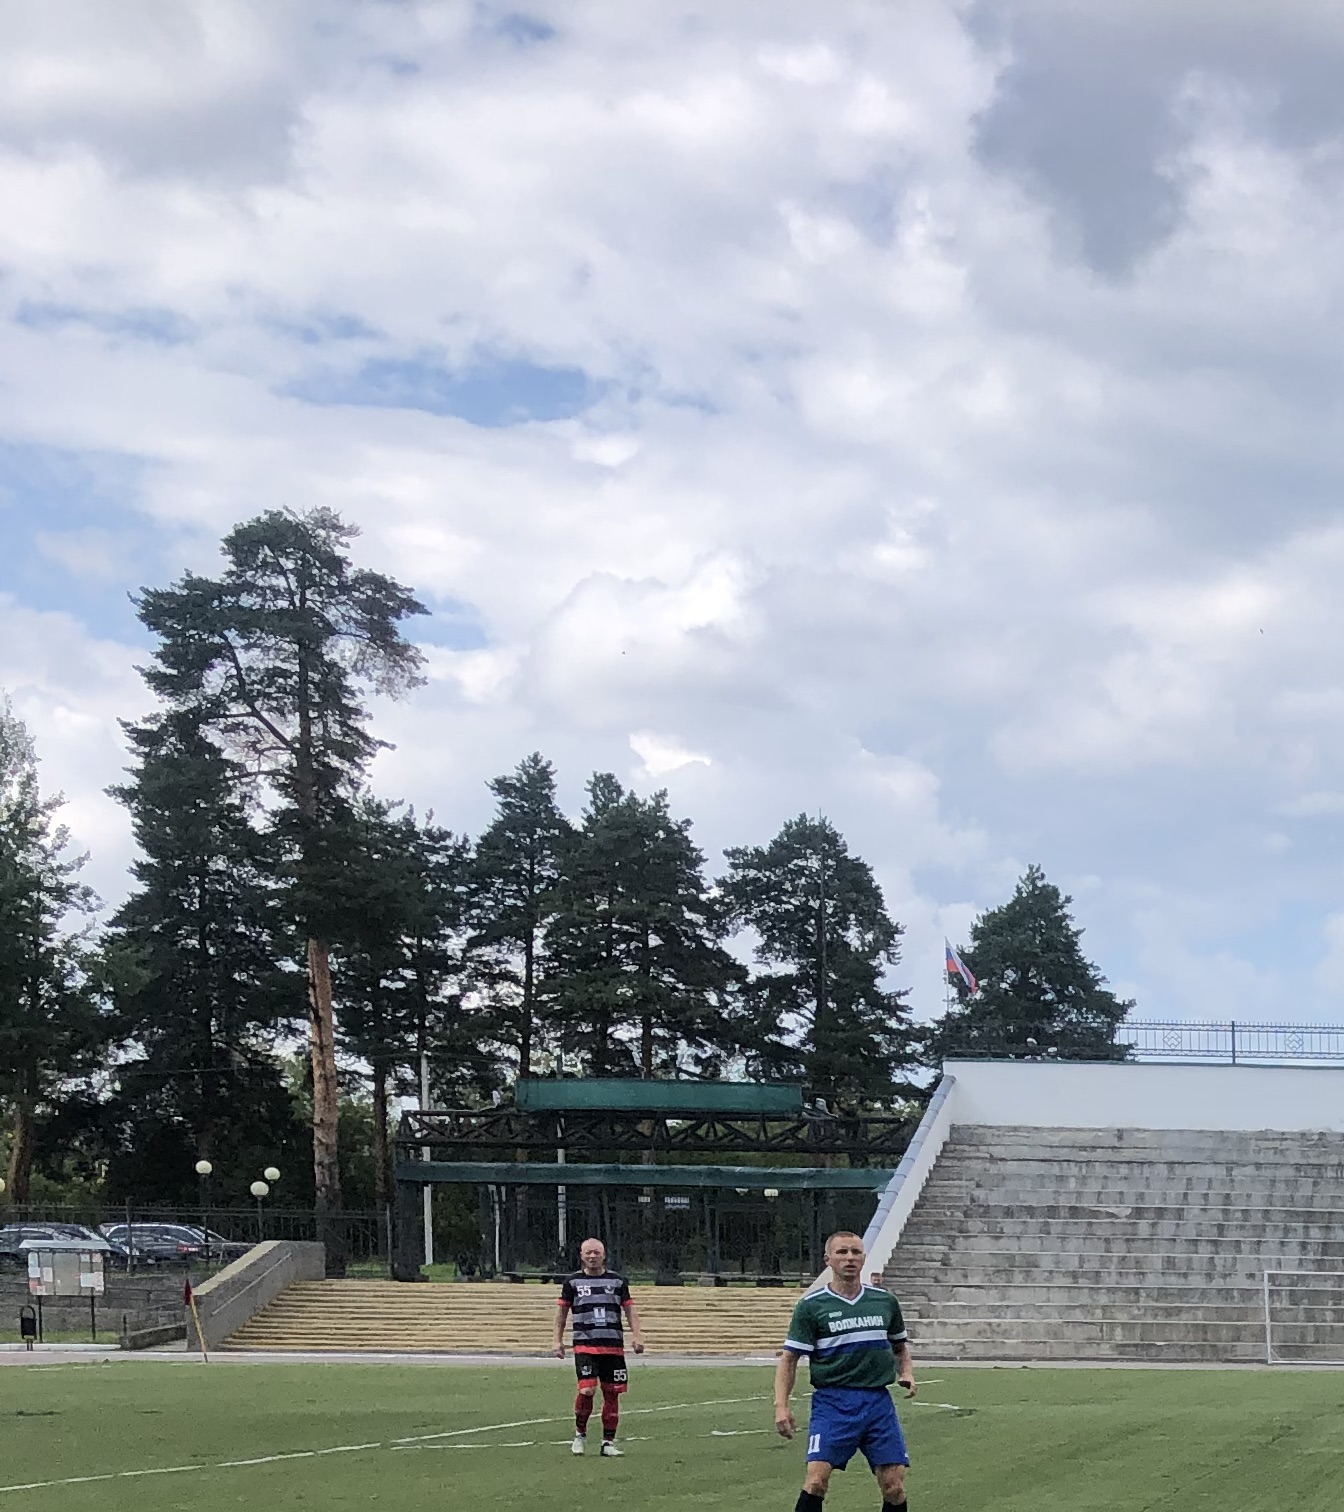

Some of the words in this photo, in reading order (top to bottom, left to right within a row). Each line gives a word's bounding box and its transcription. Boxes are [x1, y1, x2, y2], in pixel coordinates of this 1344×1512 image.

[577, 1285, 592, 1297] 55
[828, 1315, 885, 1333] ВОЛЖАНИН
[613, 1369, 628, 1382] 55
